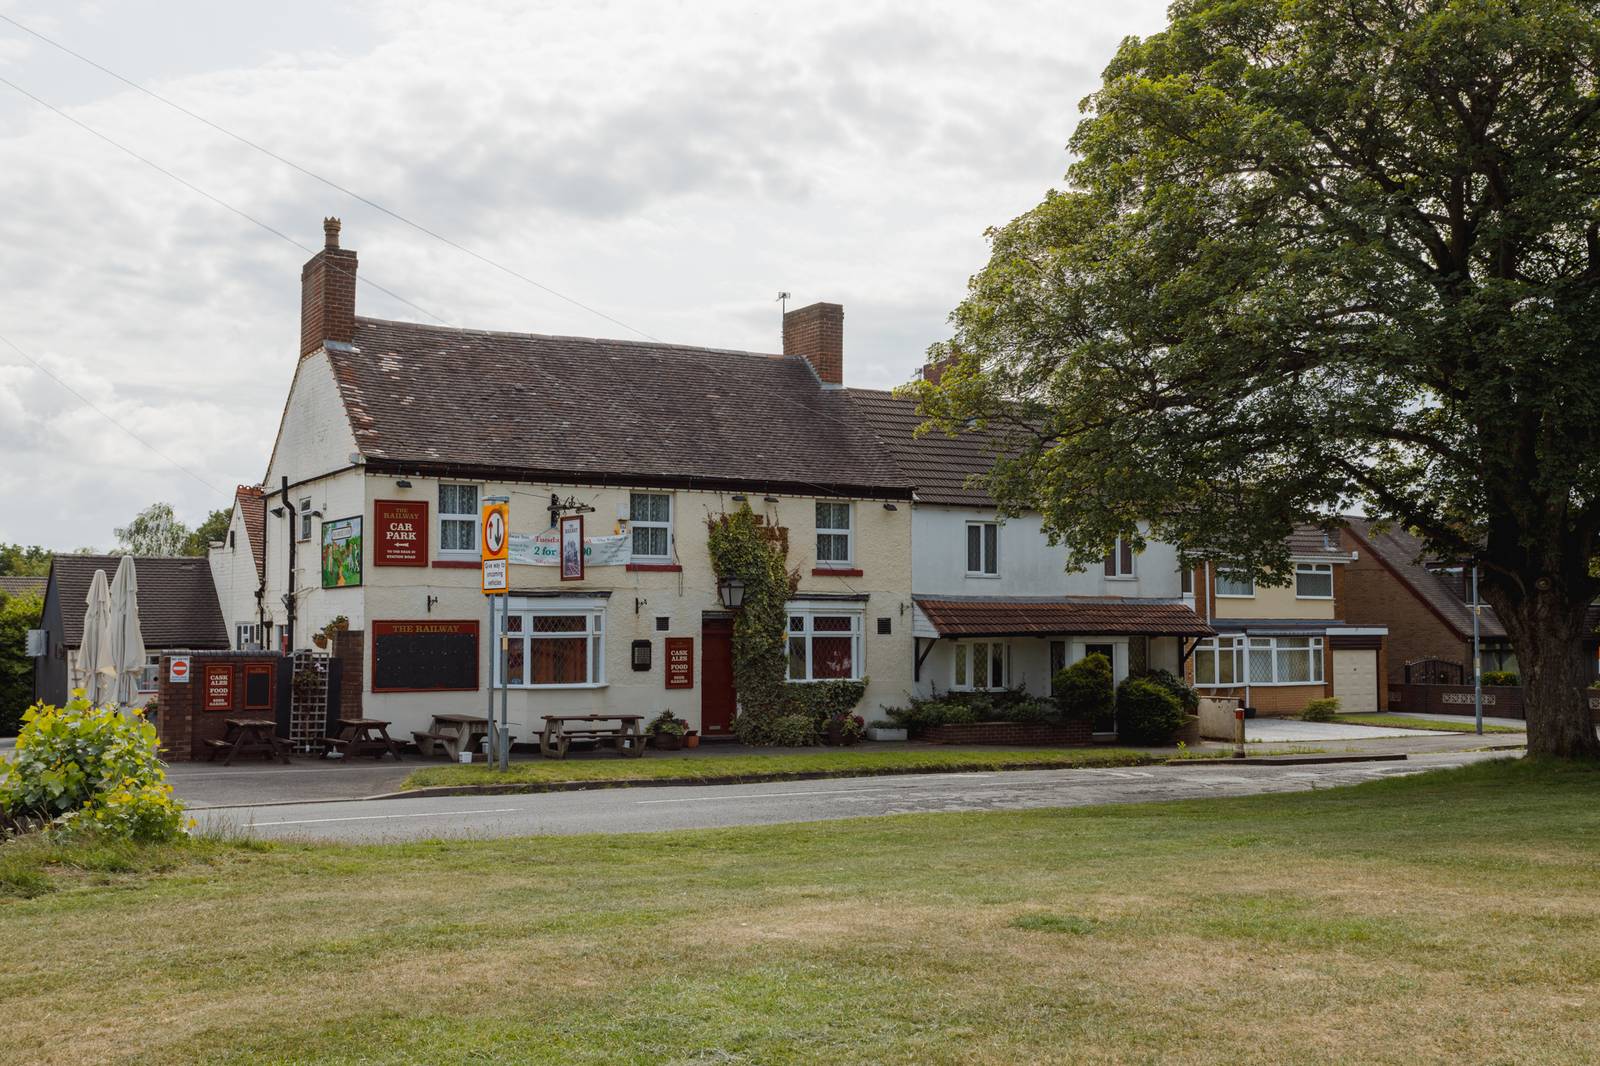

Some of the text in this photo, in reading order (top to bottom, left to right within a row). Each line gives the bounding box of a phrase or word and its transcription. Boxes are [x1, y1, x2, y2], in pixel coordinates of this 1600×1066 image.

[390, 523, 413, 531] CAR
[386, 532, 416, 540] PARK
[534, 546, 540, 556] 2
[542, 547, 556, 556] for
